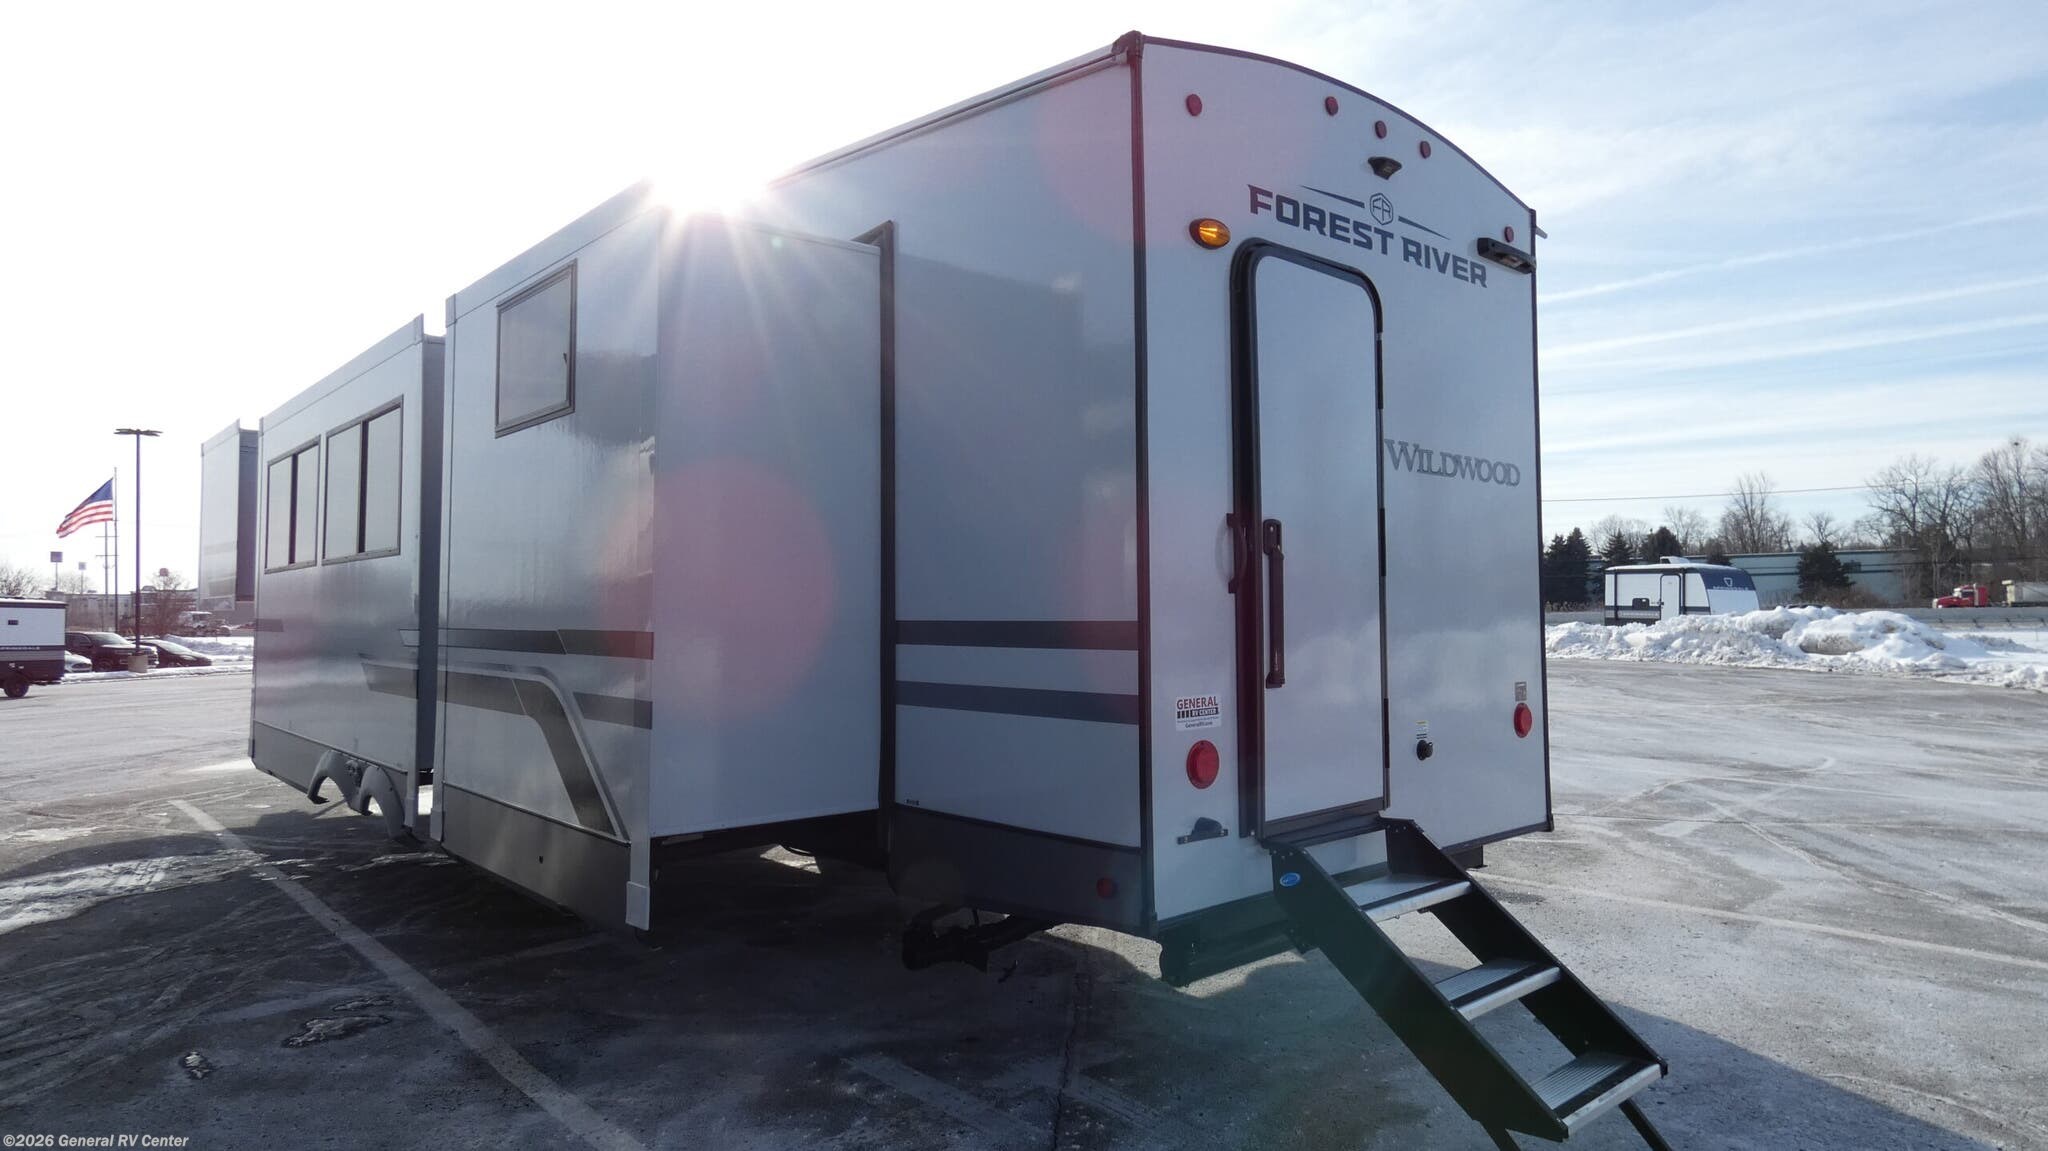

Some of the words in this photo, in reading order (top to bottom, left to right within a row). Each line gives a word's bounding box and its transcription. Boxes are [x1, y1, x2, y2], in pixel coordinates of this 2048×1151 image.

[1247, 184, 1394, 255] FOREST
[1401, 236, 1487, 288] RIVER
[1384, 438, 1521, 487] WILDWOOD
[1177, 696, 1218, 710] GENERAL
